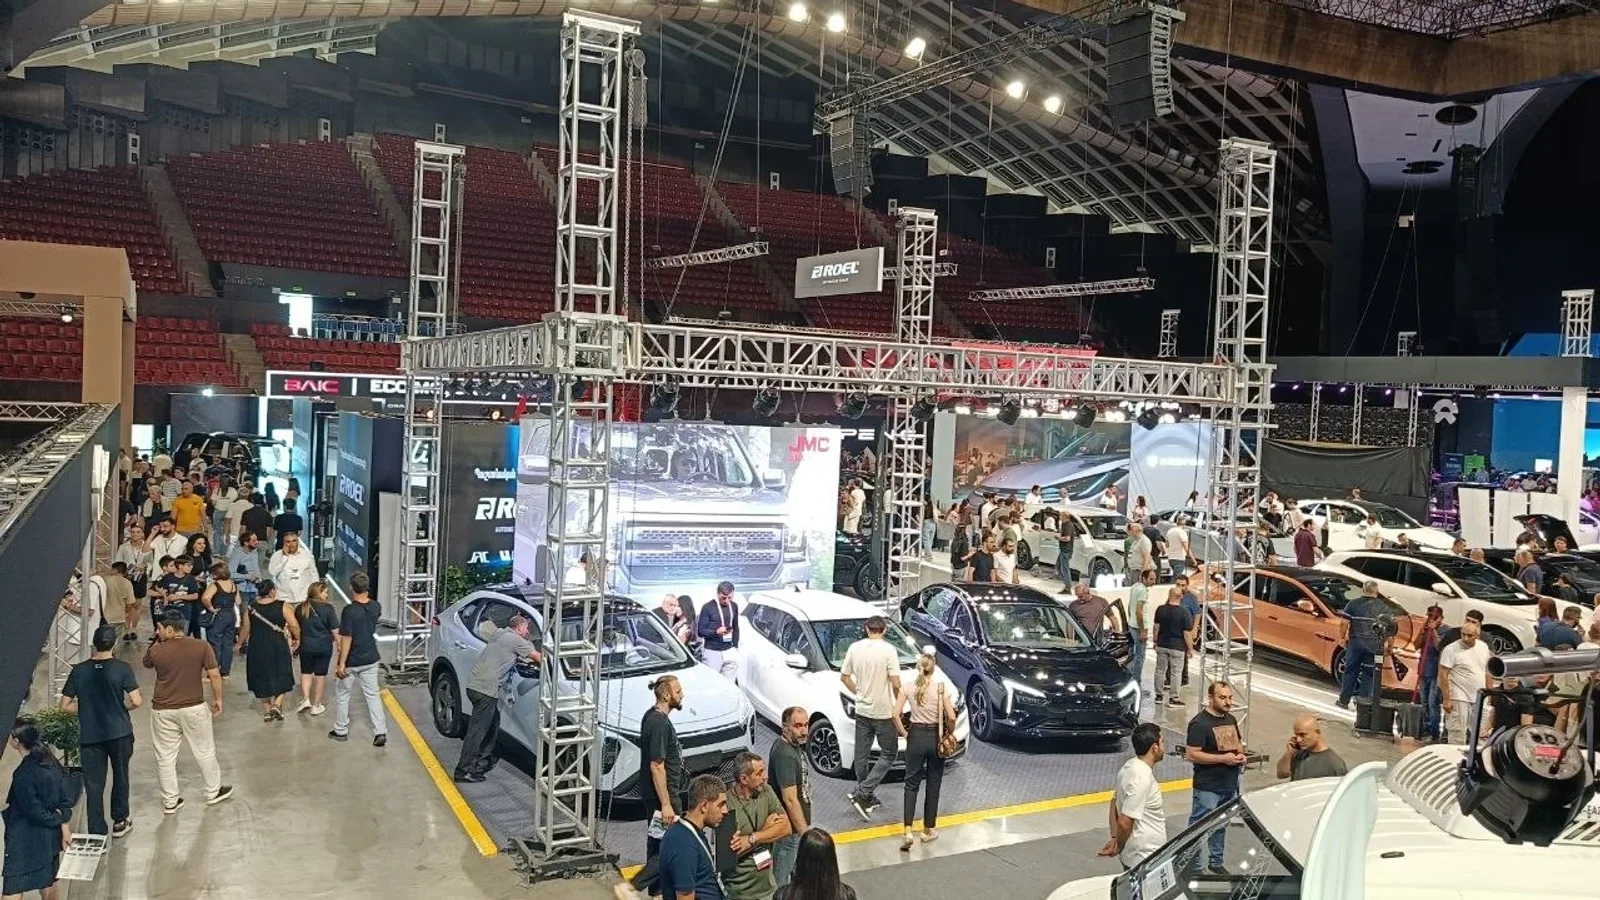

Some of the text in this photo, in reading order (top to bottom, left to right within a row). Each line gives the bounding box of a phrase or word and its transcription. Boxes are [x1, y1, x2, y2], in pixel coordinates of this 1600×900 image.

[823, 261, 859, 278] ROEL
[284, 378, 339, 393] BAIC
[788, 435, 830, 452] JMC
